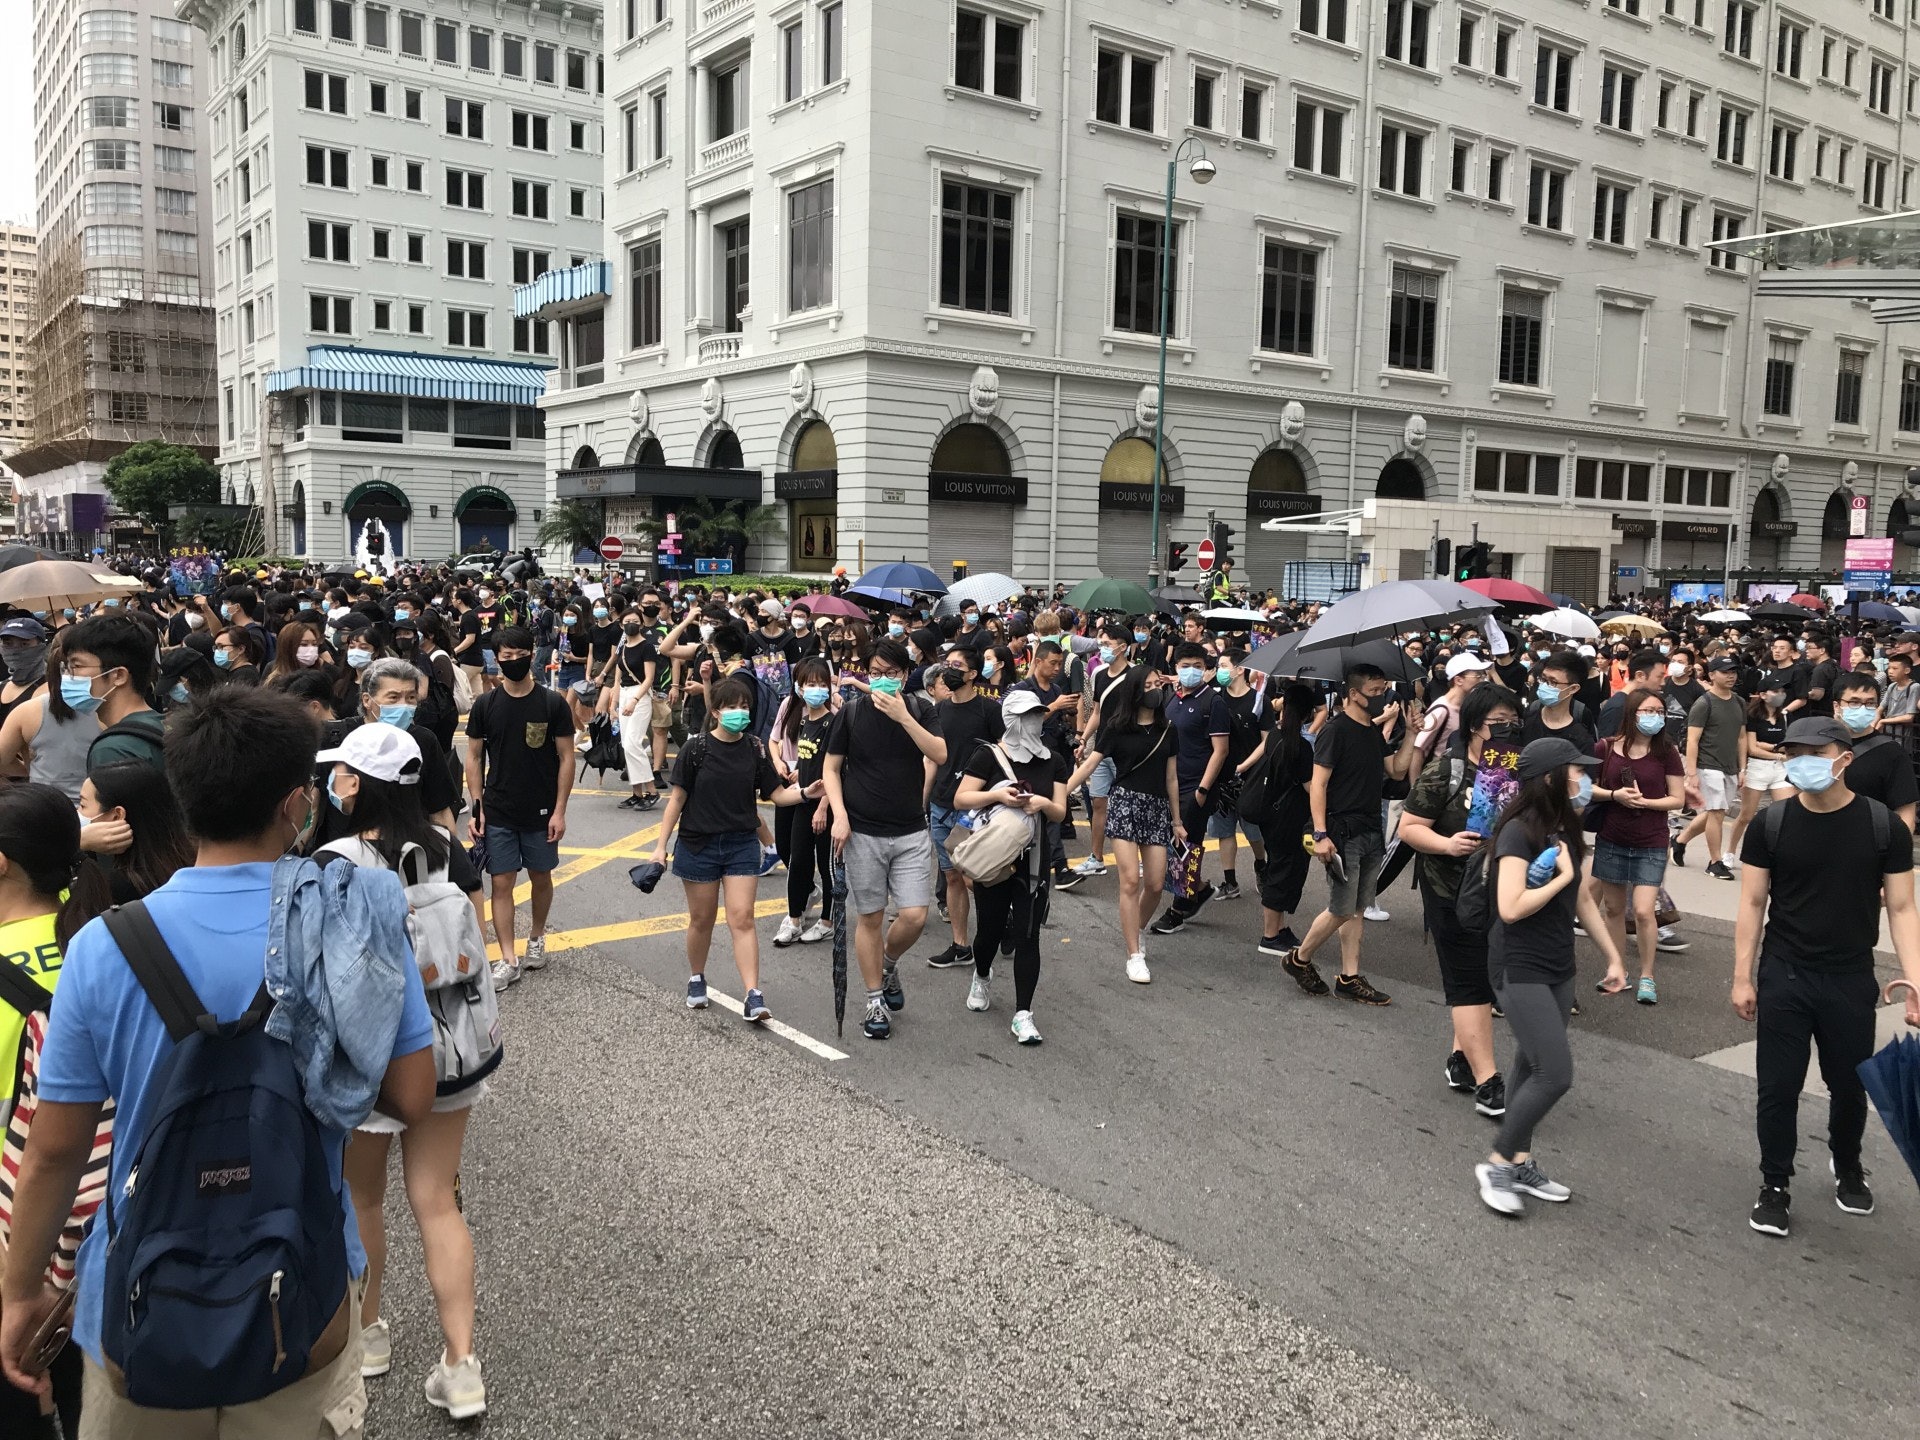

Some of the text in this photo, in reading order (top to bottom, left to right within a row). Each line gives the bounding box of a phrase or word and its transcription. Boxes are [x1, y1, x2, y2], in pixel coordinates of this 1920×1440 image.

[780, 478, 826, 490] LOUIS VUITTON
[944, 481, 1016, 495] LOUIS VUITTON
[1113, 491, 1174, 503] LOUIS VUION
[1259, 499, 1313, 511] LOUIS VUITTON
[1687, 525, 1719, 534] GOYARD
[1765, 522, 1793, 530] GOYARD
